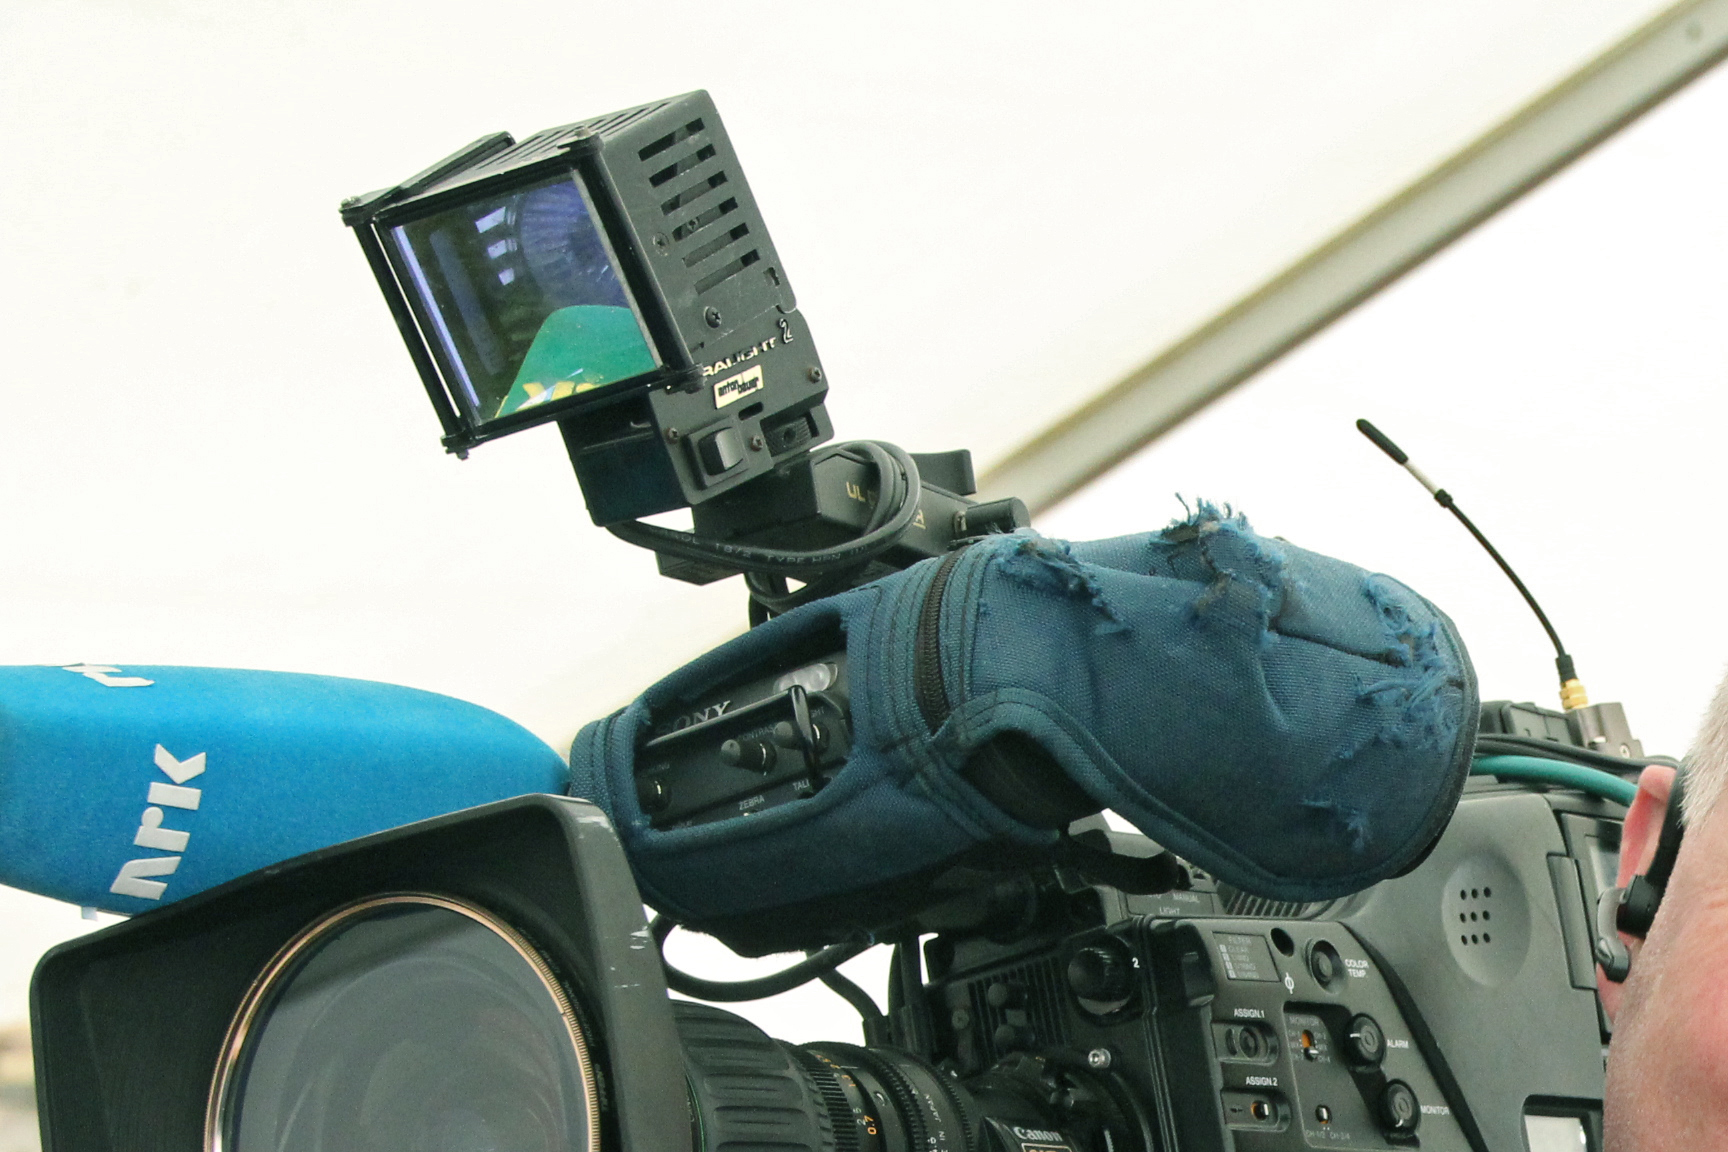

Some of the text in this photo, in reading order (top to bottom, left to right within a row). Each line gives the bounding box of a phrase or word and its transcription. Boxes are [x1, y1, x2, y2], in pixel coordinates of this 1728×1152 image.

[739, 794, 765, 810] ZEBRA
[1132, 957, 1140, 969] 2
[1386, 1039, 1409, 1050] ALARM
[924, 1093, 942, 1122] JAPAN
[1421, 1105, 1450, 1116] MONITOR
[938, 1131, 946, 1141] IN
[1013, 1126, 1063, 1141] Canon
